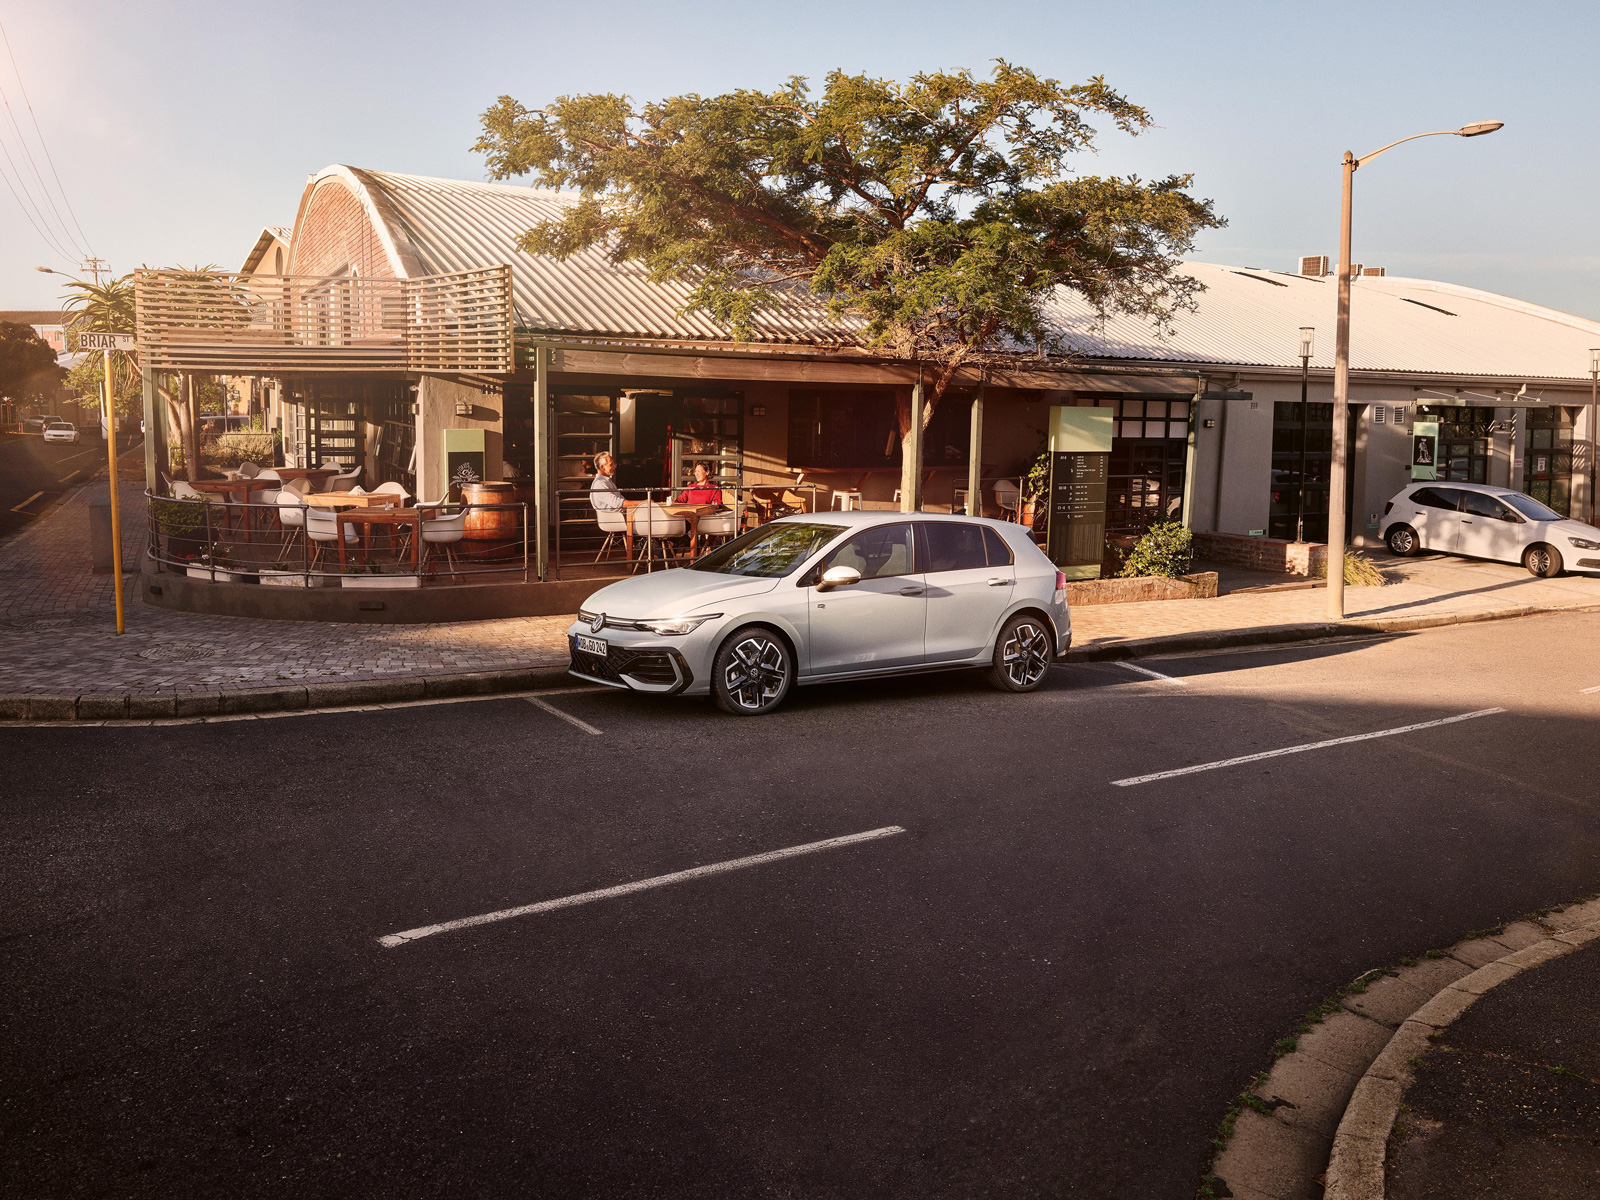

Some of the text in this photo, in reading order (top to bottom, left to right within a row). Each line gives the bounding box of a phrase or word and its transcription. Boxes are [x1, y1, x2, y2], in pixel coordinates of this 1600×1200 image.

[81, 335, 129, 348] BRIAR ST
[595, 641, 606, 655] 242
